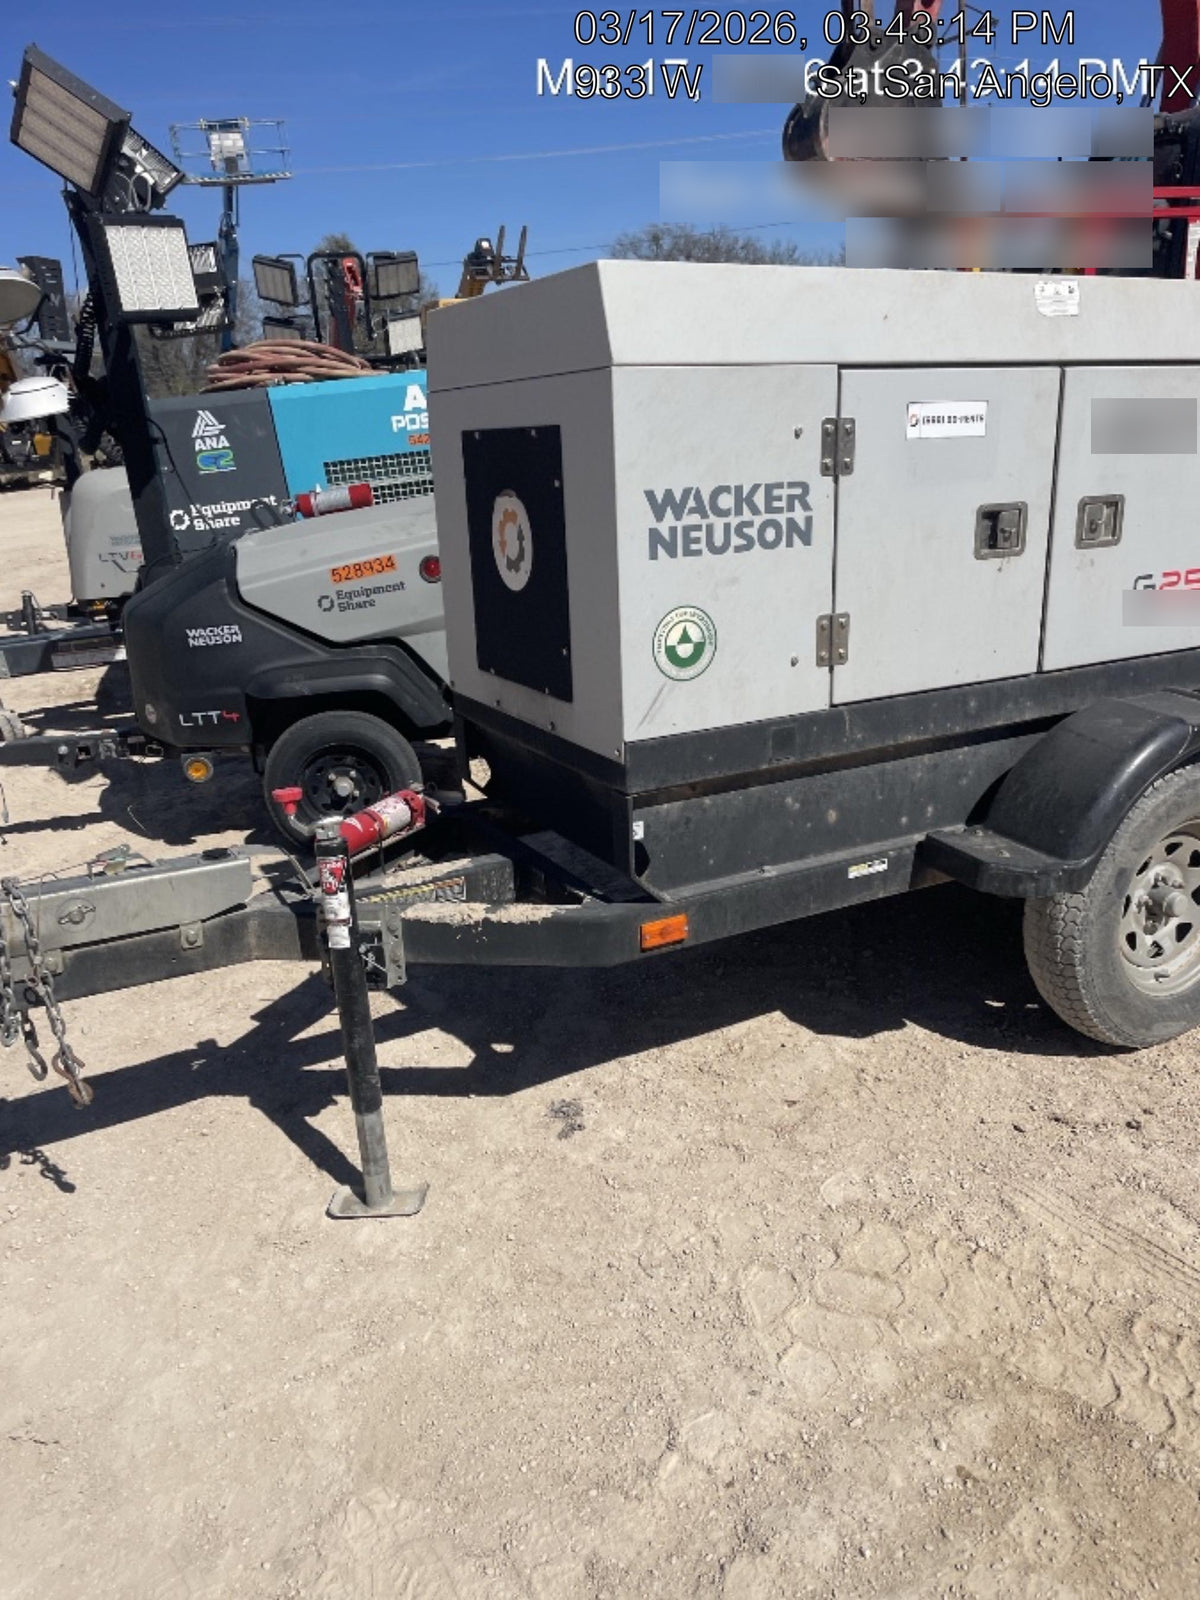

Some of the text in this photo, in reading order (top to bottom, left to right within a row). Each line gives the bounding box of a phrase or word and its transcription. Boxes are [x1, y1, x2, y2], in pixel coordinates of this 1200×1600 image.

[194, 435, 231, 451] ANA
[643, 481, 813, 523] WACKER
[648, 515, 813, 560] NEUSON
[331, 555, 396, 583] 528934
[335, 581, 406, 602] Equipment
[337, 599, 376, 613] Share
[186, 625, 241, 638] WACKER
[188, 634, 243, 648] NEUSON
[179, 711, 240, 727] LTT4
